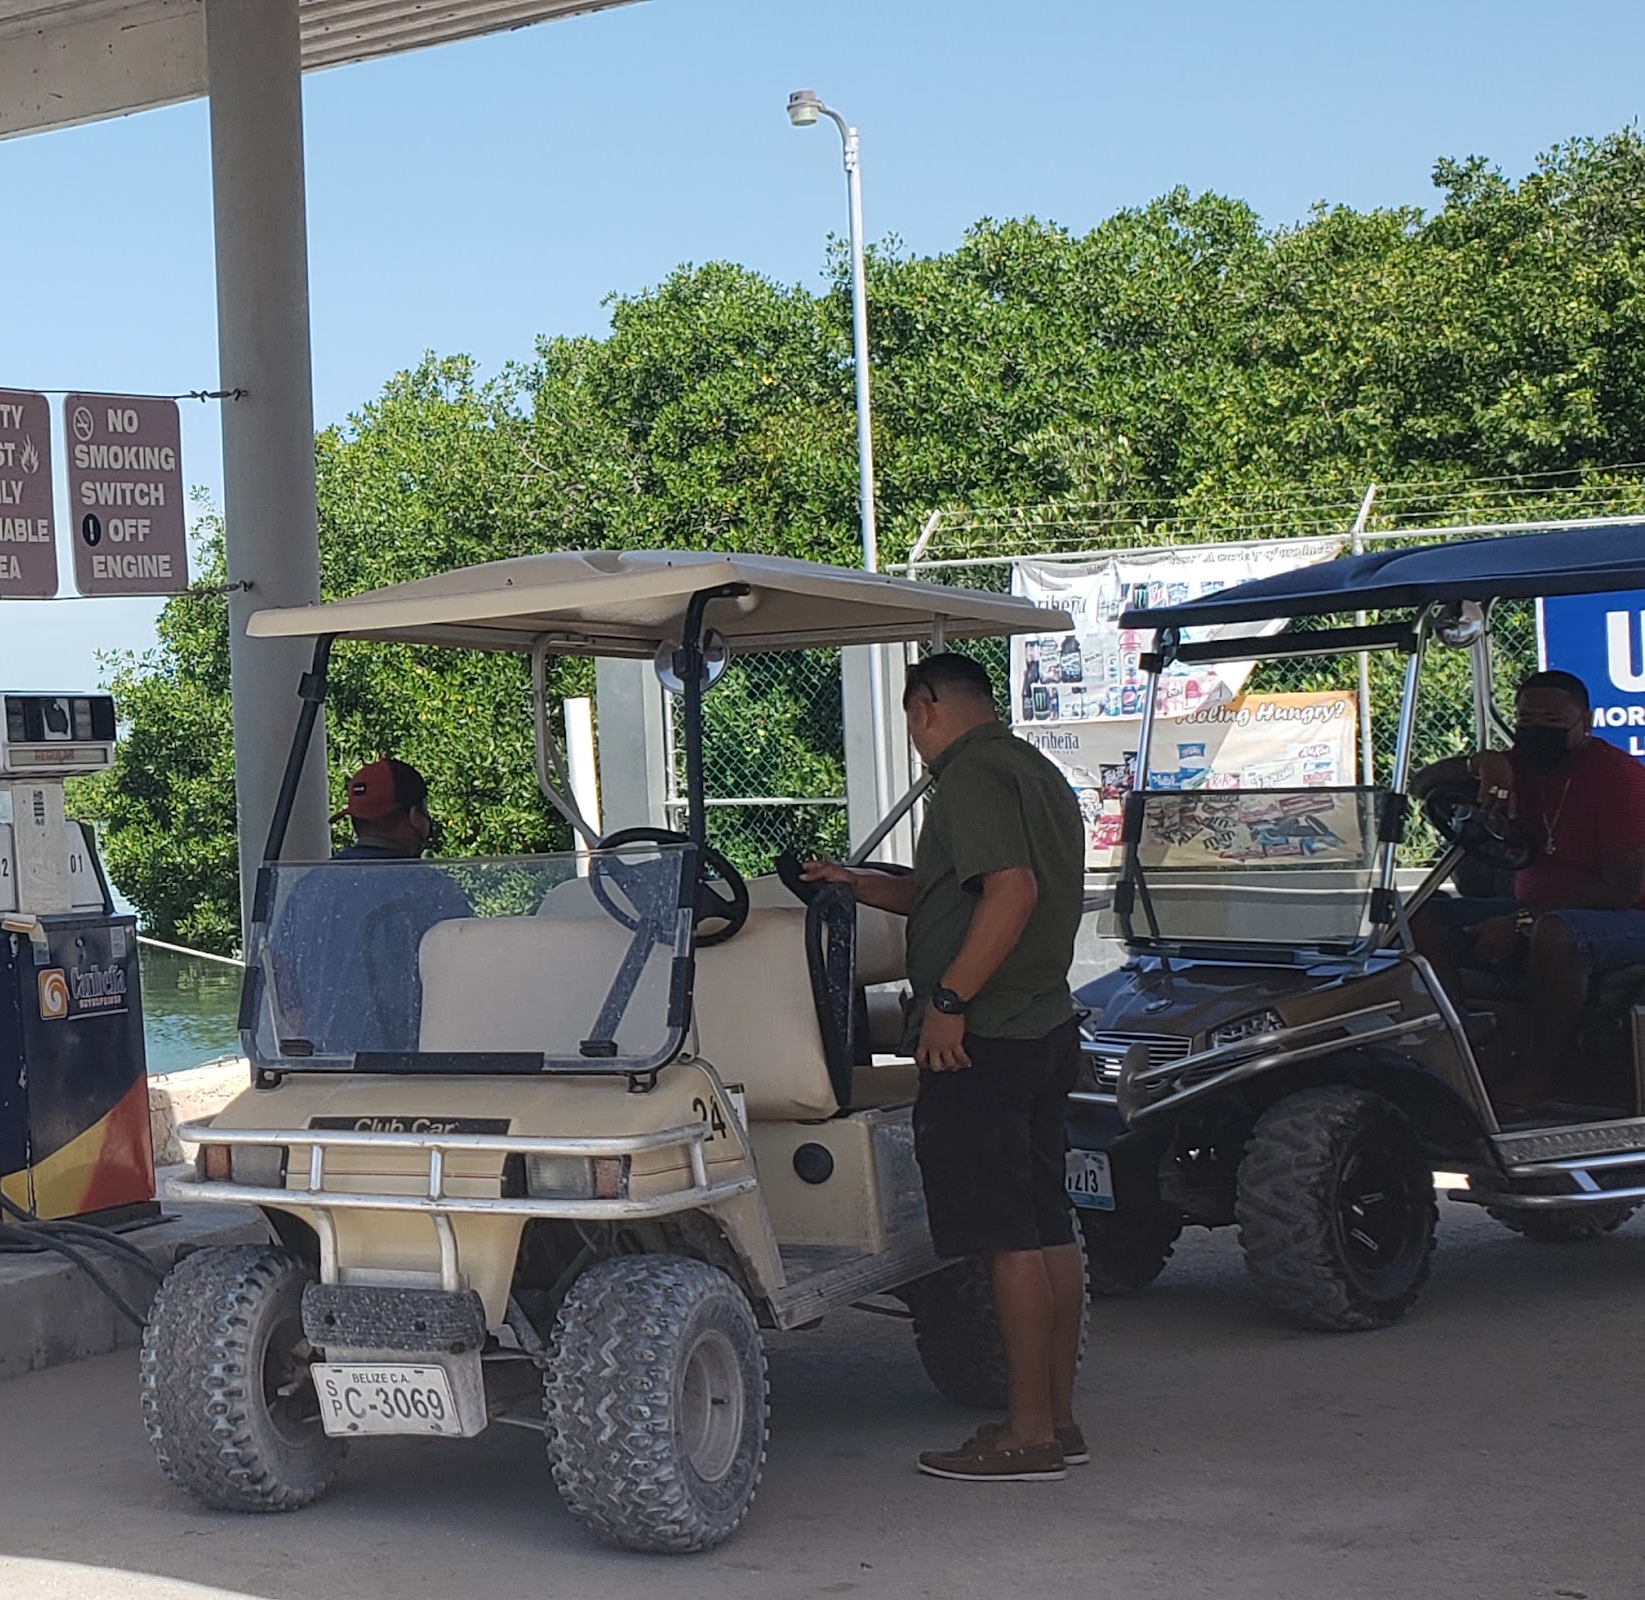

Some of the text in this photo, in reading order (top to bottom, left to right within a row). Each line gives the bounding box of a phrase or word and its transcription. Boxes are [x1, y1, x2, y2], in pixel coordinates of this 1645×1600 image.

[107, 408, 138, 433] NO
[74, 445, 176, 472] SMOKING
[81, 481, 165, 506] SWITCH
[108, 518, 151, 542] OFF
[92, 555, 172, 579] ENGINE
[1255, 700, 1346, 725] Hungry?
[70, 854, 84, 874] 01
[354, 1117, 457, 1134] Club Car
[352, 1373, 388, 1384] BELIZE
[344, 1386, 446, 1421] C-3069
